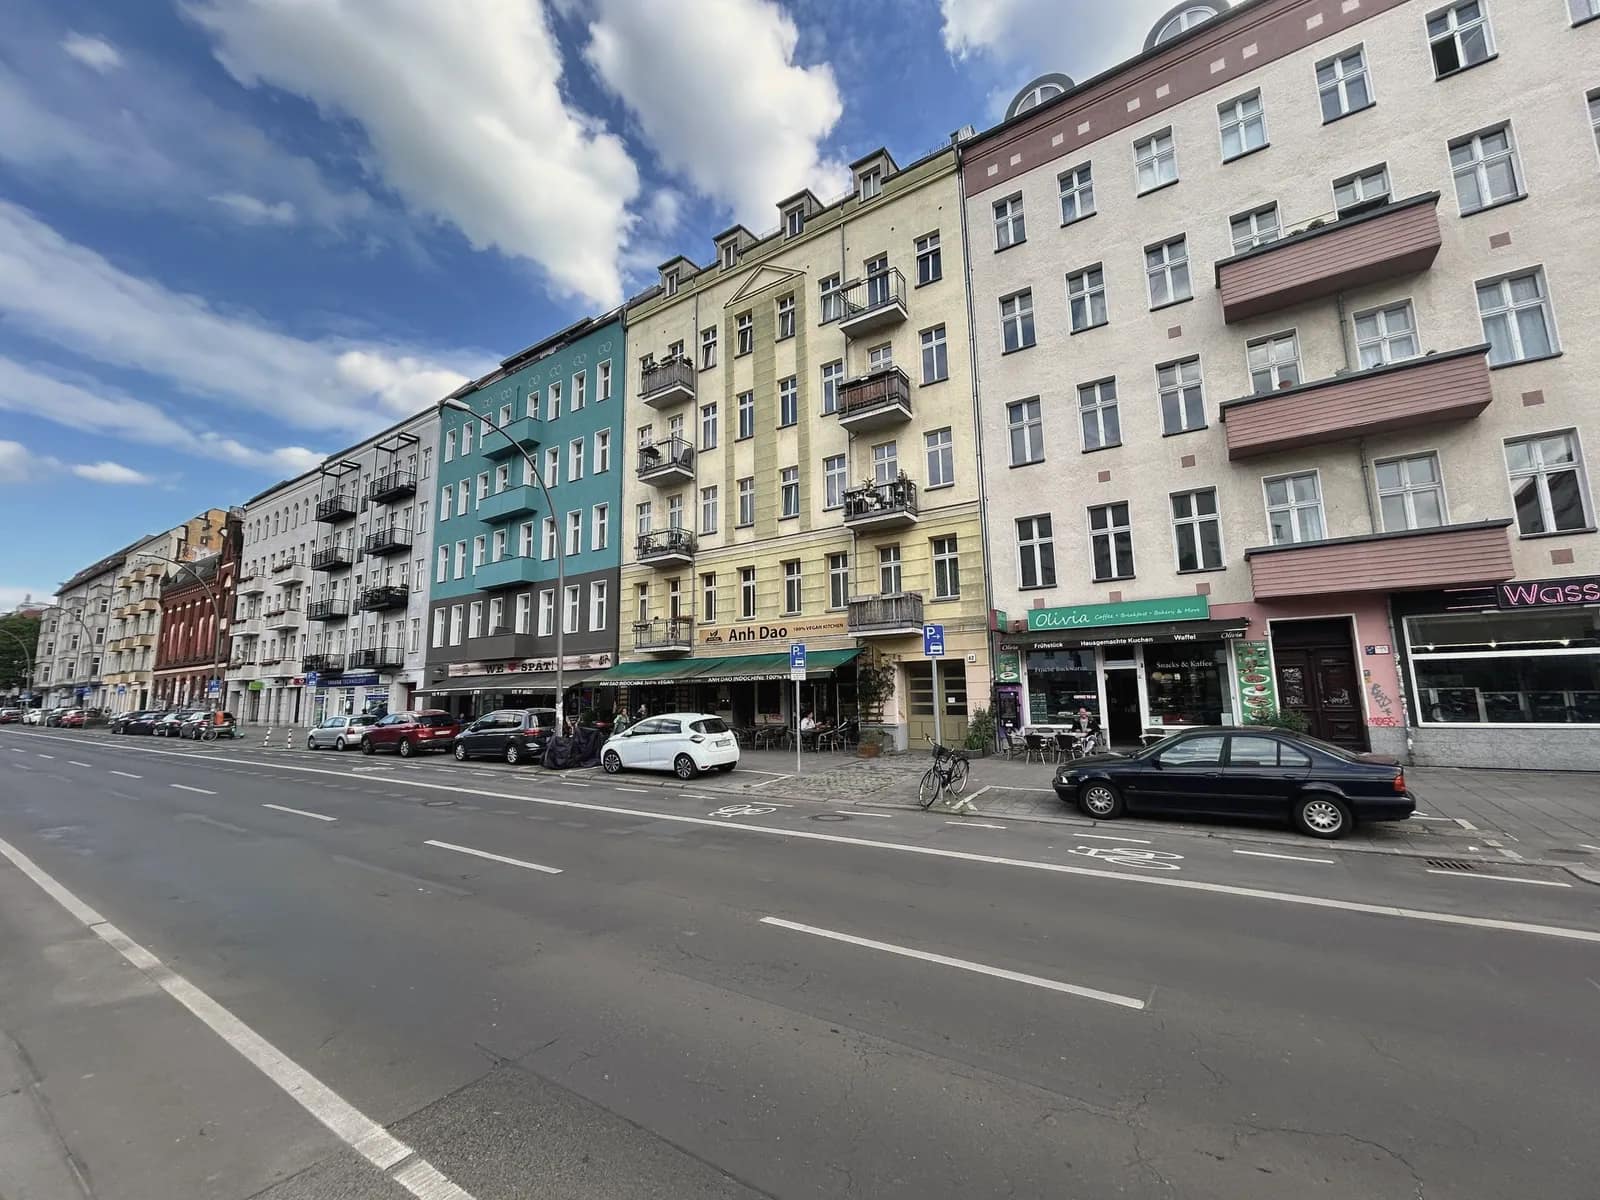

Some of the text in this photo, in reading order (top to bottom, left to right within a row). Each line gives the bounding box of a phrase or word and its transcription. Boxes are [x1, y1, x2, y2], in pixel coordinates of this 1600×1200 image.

[1035, 610, 1090, 627] Olivia
[729, 627, 755, 641] Anh
[760, 626, 787, 639] Dao
[926, 627, 935, 639] P
[1173, 633, 1197, 641] Waffel
[1220, 631, 1243, 639] Olivia
[1034, 641, 1063, 649] Frühstück
[1080, 638, 1127, 646] Hausgemachte
[792, 646, 800, 656] P
[486, 664, 504, 674] WE
